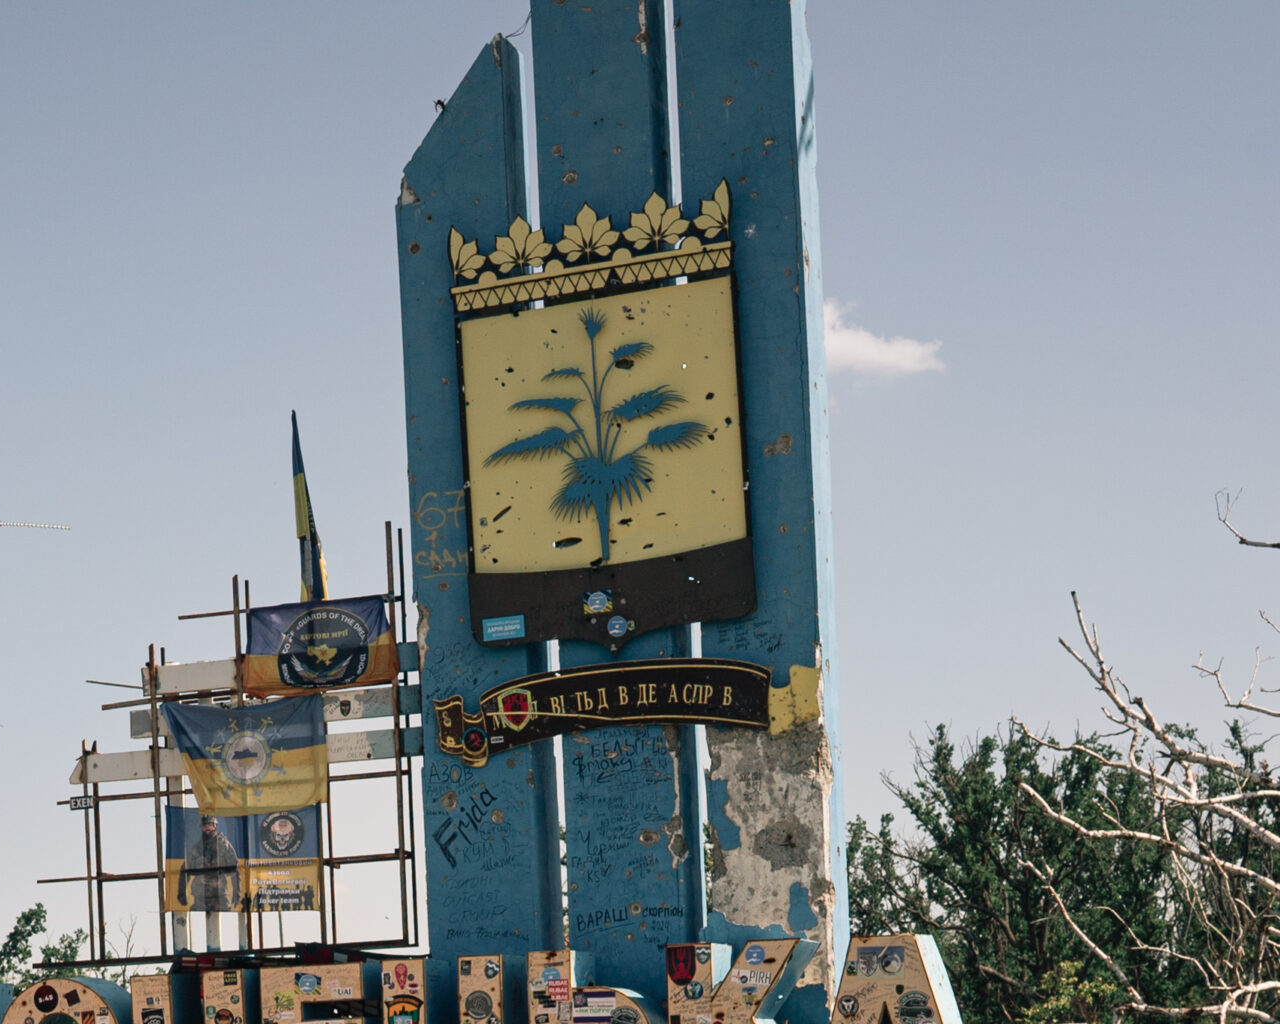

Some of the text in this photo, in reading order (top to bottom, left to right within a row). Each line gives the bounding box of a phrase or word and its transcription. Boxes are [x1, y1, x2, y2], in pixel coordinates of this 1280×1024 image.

[416, 490, 465, 530] 67
[328, 613, 340, 621] OF
[341, 614, 358, 626] THE
[432, 788, 497, 868] Frida
[576, 906, 629, 931] ВАРАШ
